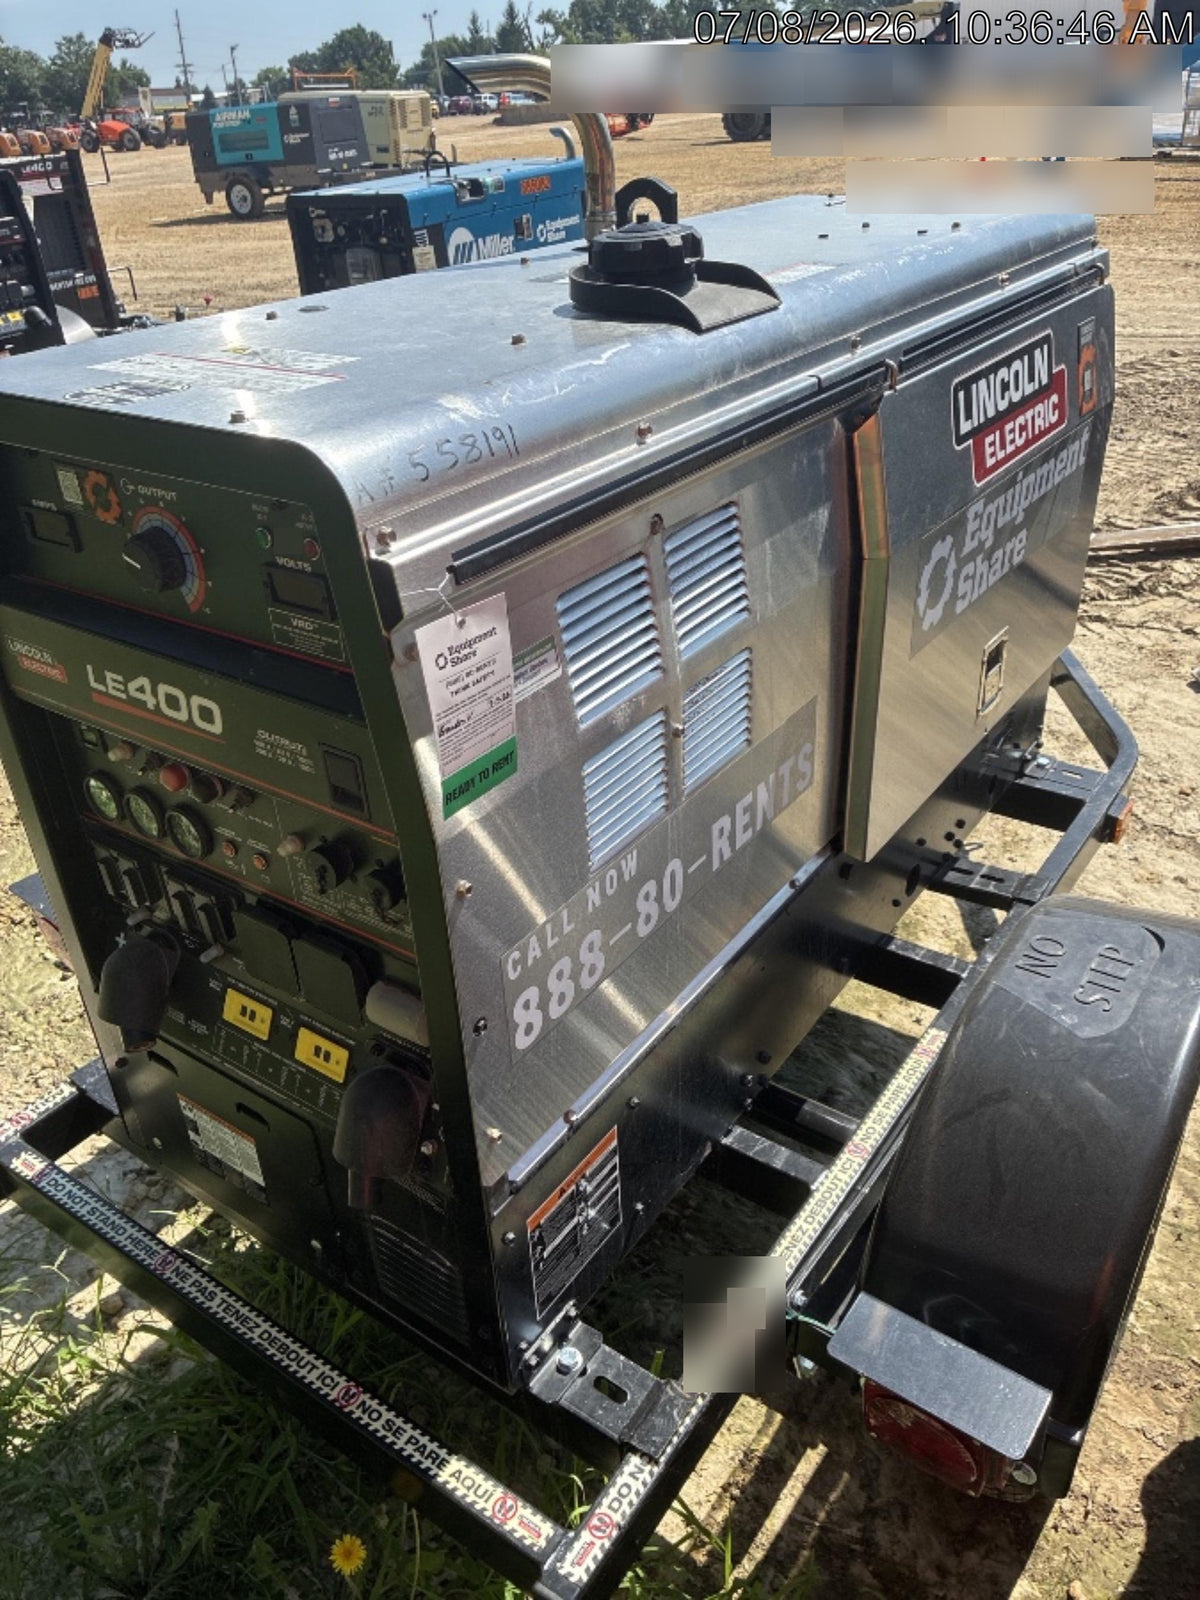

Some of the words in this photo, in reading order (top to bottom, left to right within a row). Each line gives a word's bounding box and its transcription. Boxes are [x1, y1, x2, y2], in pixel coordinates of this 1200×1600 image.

[478, 232, 515, 260] Miller
[957, 344, 1049, 436] LINCOLN
[984, 393, 1059, 468] ELECTRIC
[137, 484, 177, 501] OUTPUT
[961, 425, 1091, 558] Equipment
[274, 555, 312, 572] VOLTS
[956, 527, 1028, 615] Share
[447, 626, 497, 656] Equipment
[449, 649, 477, 668] Share
[86, 664, 223, 735] LE400
[445, 775, 476, 806] READY
[478, 767, 490, 783] TO
[491, 750, 514, 776] RENT
[507, 908, 575, 980] CALL
[586, 849, 638, 913] NOW
[512, 743, 814, 1050] 888-80-RENTS
[1014, 934, 1067, 979] NO
[860, 1125, 877, 1144] NO
[46, 1176, 67, 1194] DO
[65, 1189, 91, 1213] NOT
[87, 1206, 127, 1237] STAND
[124, 1231, 160, 1262] HERE
[169, 1265, 189, 1285] NE
[187, 1278, 219, 1304] PAS
[215, 1297, 260, 1334] TENEZ
[256, 1327, 322, 1382] DEBOUT
[315, 1370, 341, 1393] ICI
[355, 1400, 383, 1423] NO
[380, 1417, 405, 1442] SE
[402, 1436, 451, 1473] PARE
[606, 1482, 634, 1514] DO
